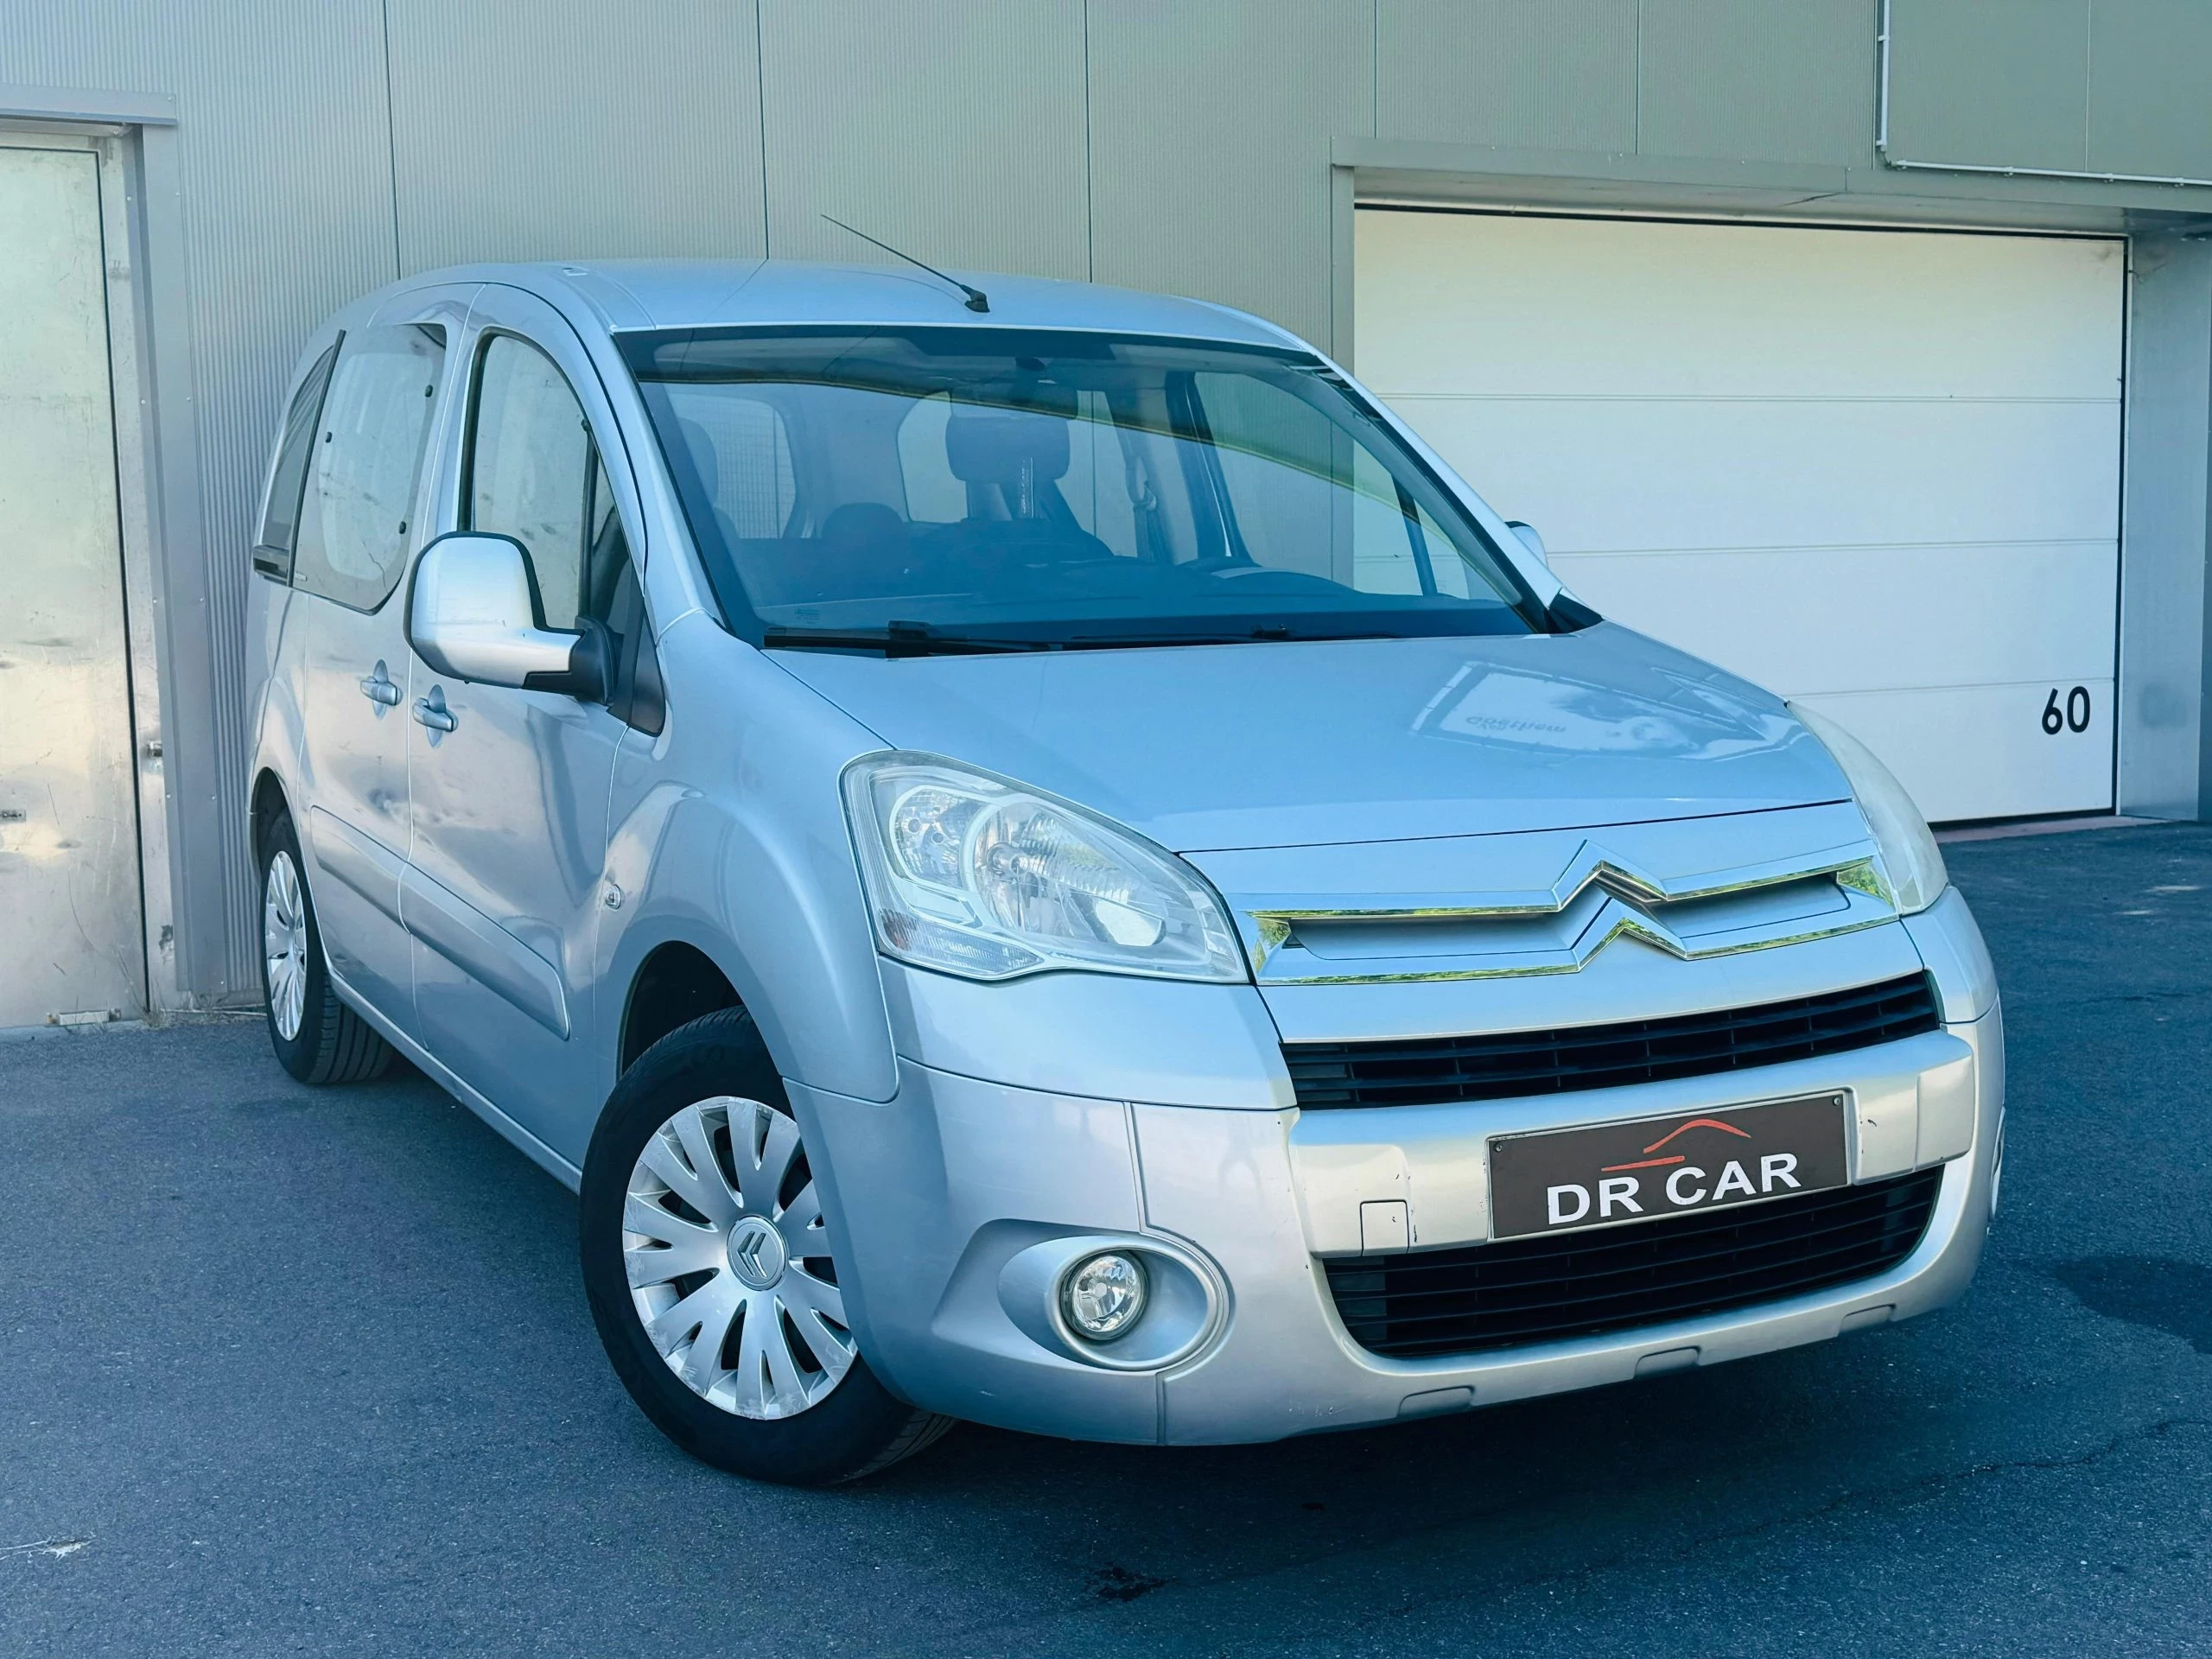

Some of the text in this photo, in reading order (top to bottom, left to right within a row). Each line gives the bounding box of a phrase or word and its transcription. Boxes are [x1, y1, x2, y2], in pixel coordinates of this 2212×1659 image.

[2042, 686, 2090, 734] 60
[1547, 1153, 1802, 1225] DR CAR
